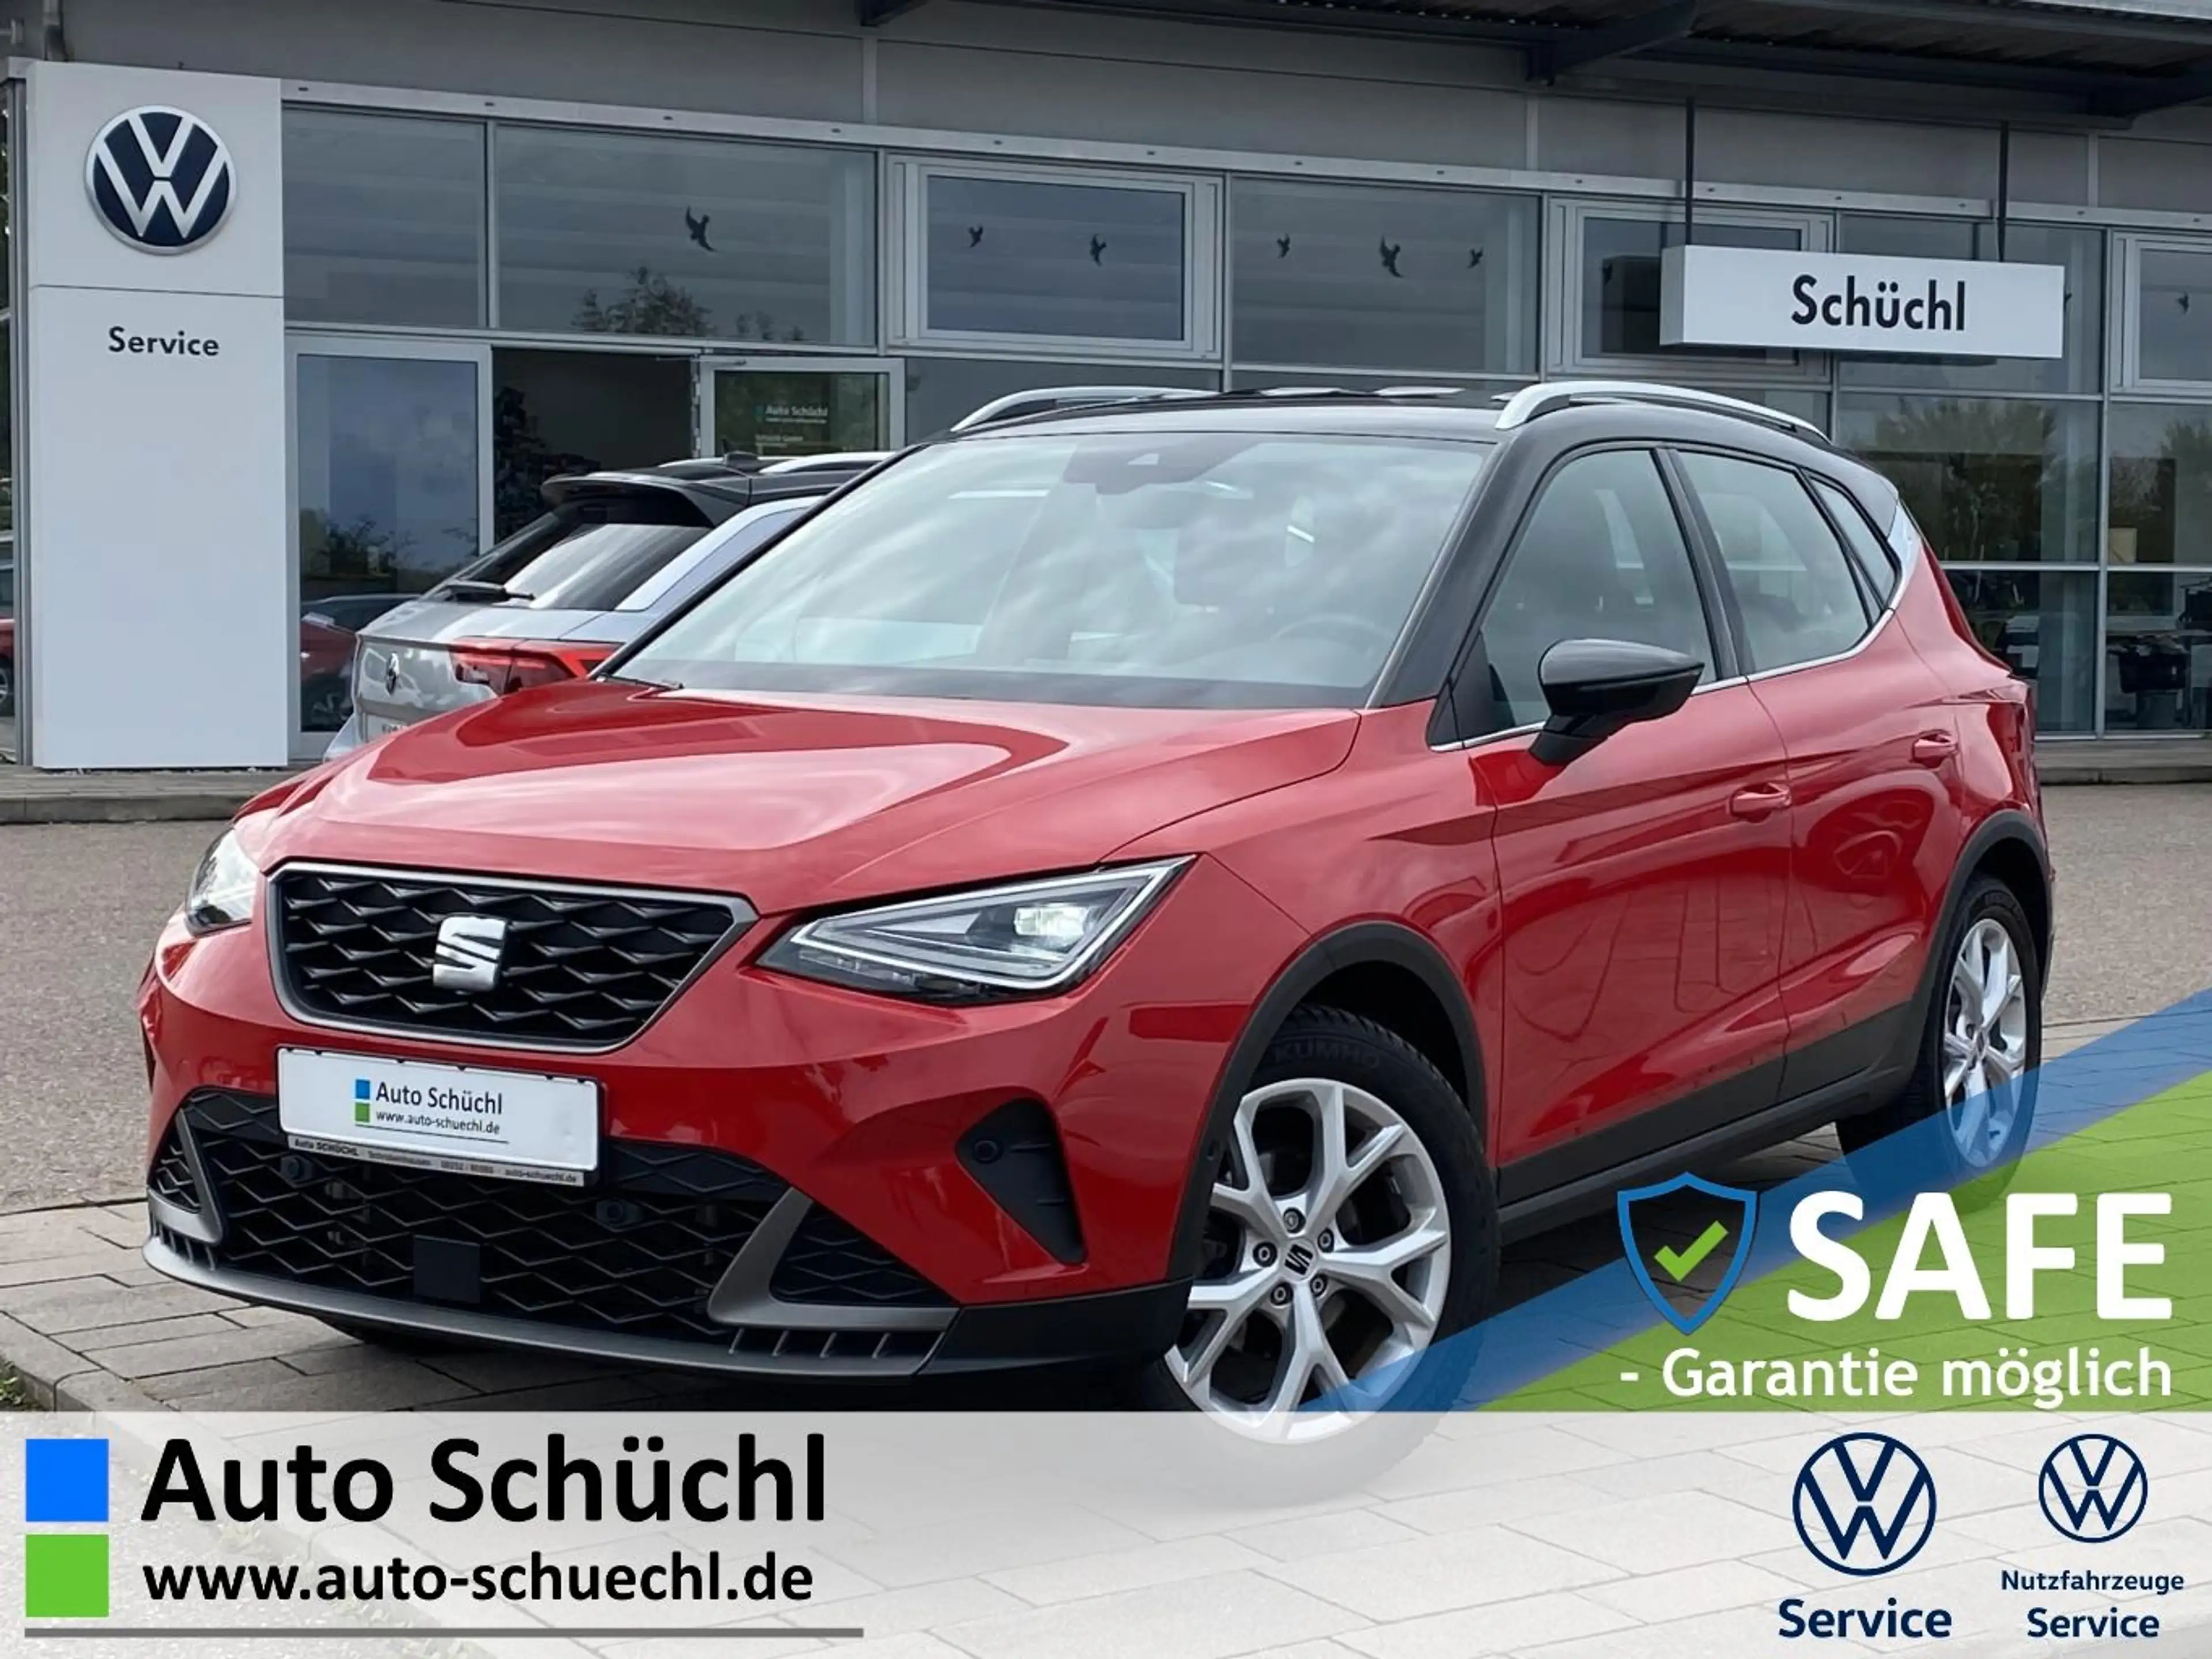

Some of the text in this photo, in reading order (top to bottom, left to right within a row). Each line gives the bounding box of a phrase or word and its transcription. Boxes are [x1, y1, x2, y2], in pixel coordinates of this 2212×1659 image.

[1791, 274, 1966, 331] Schüchl
[108, 326, 220, 357] Service
[1275, 1036, 1380, 1069] KUMHO
[376, 1081, 502, 1115] Auto Schüchl
[376, 1111, 500, 1135] www.auto-schuechl.de
